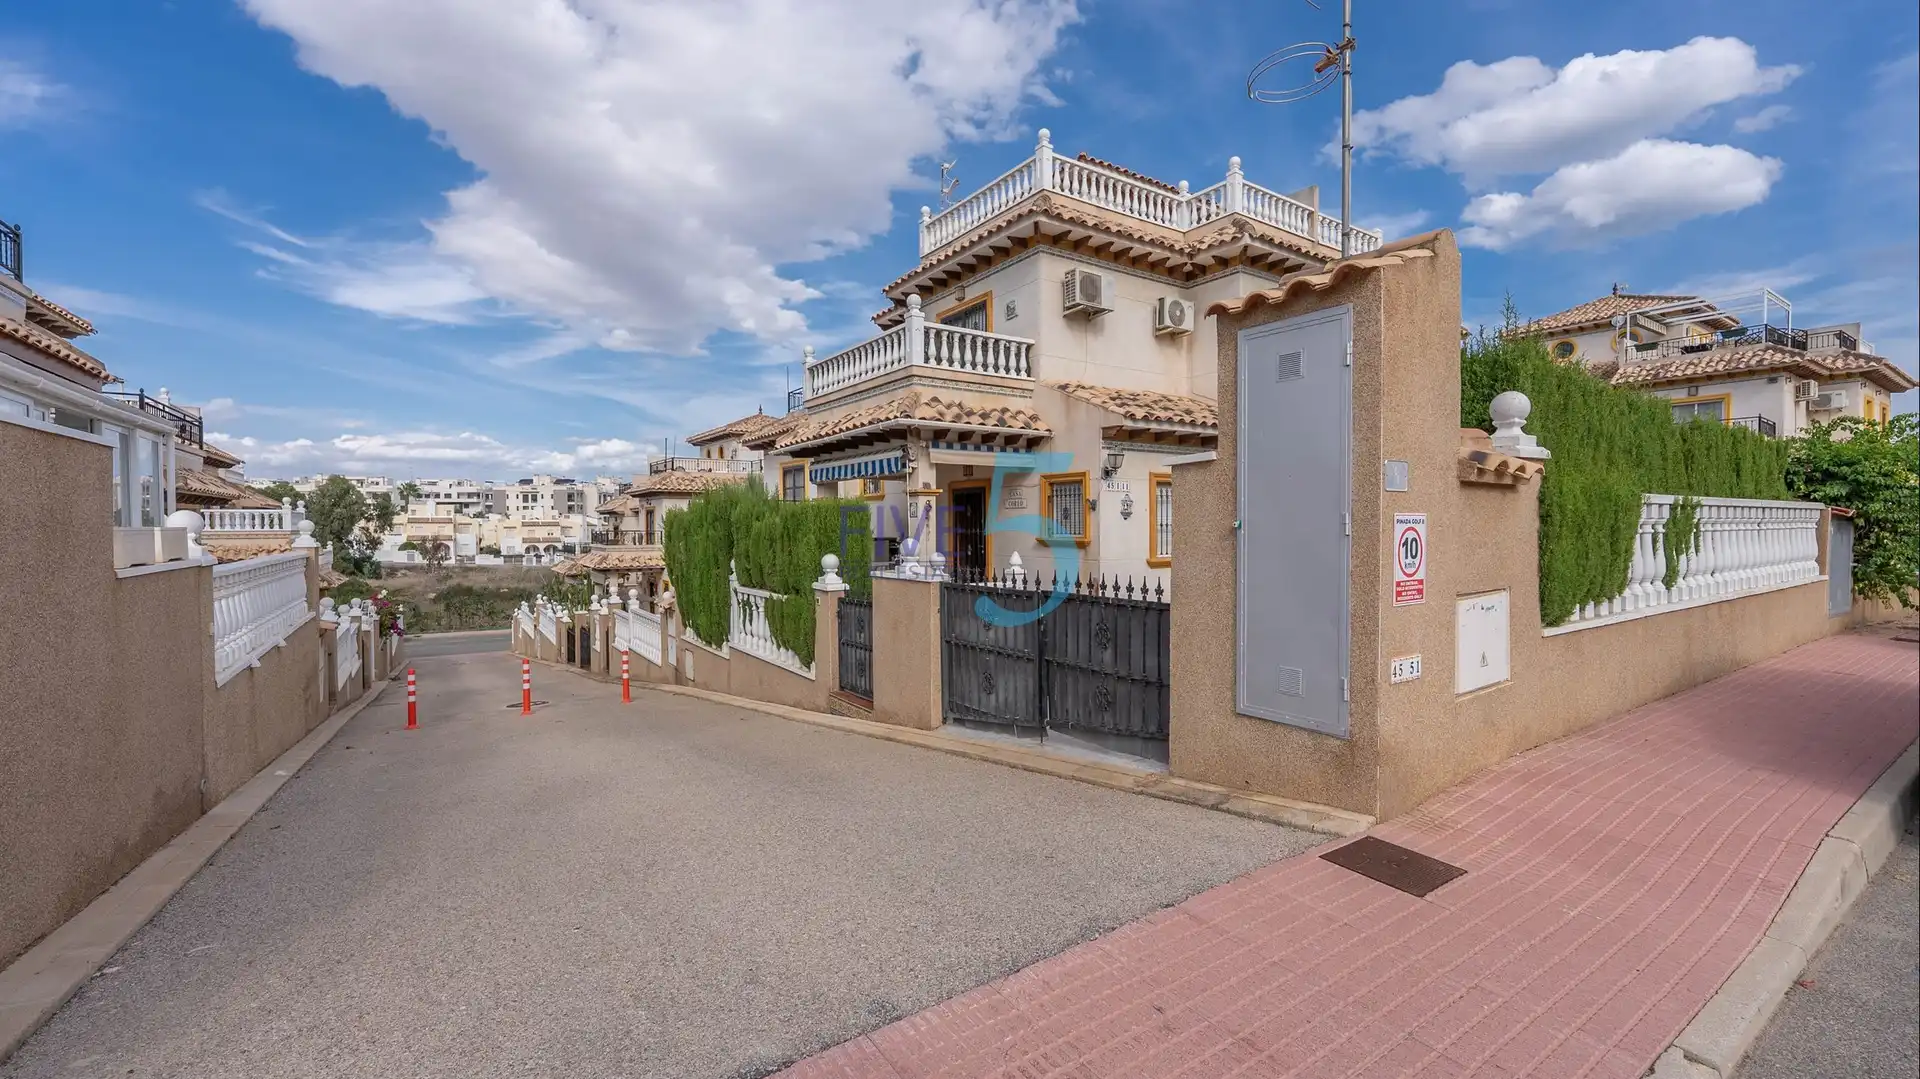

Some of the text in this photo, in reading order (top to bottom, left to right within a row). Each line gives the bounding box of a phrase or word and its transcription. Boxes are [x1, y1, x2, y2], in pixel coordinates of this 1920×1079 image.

[1402, 536, 1419, 560] 10
[1392, 660, 1420, 678] 45 51
